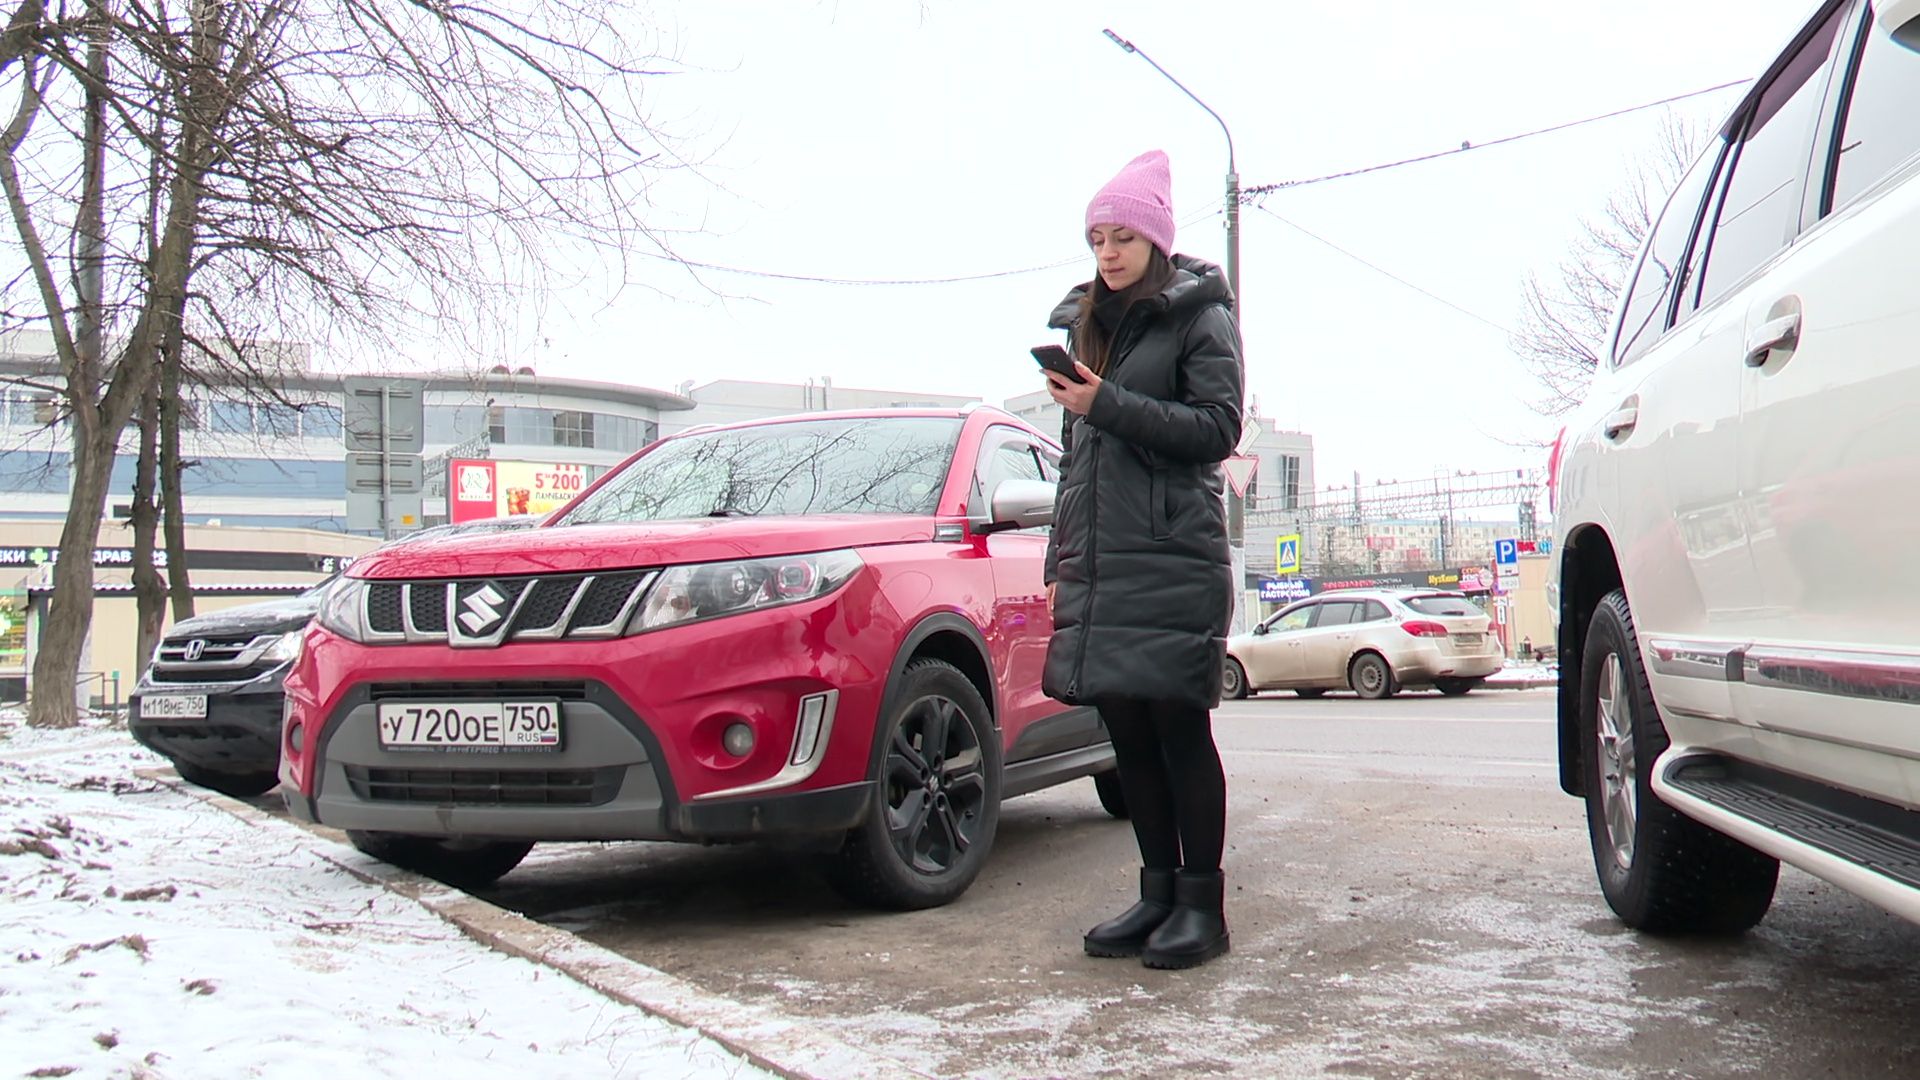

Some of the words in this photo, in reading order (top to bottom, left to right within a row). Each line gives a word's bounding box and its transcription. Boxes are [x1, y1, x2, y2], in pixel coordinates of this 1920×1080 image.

[1260, 589, 1310, 599] ГАСТРОНОМ
[185, 696, 205, 710] 750
[389, 708, 499, 742] У720ОЕ
[505, 705, 551, 732] 750
[517, 732, 540, 742] RUS
